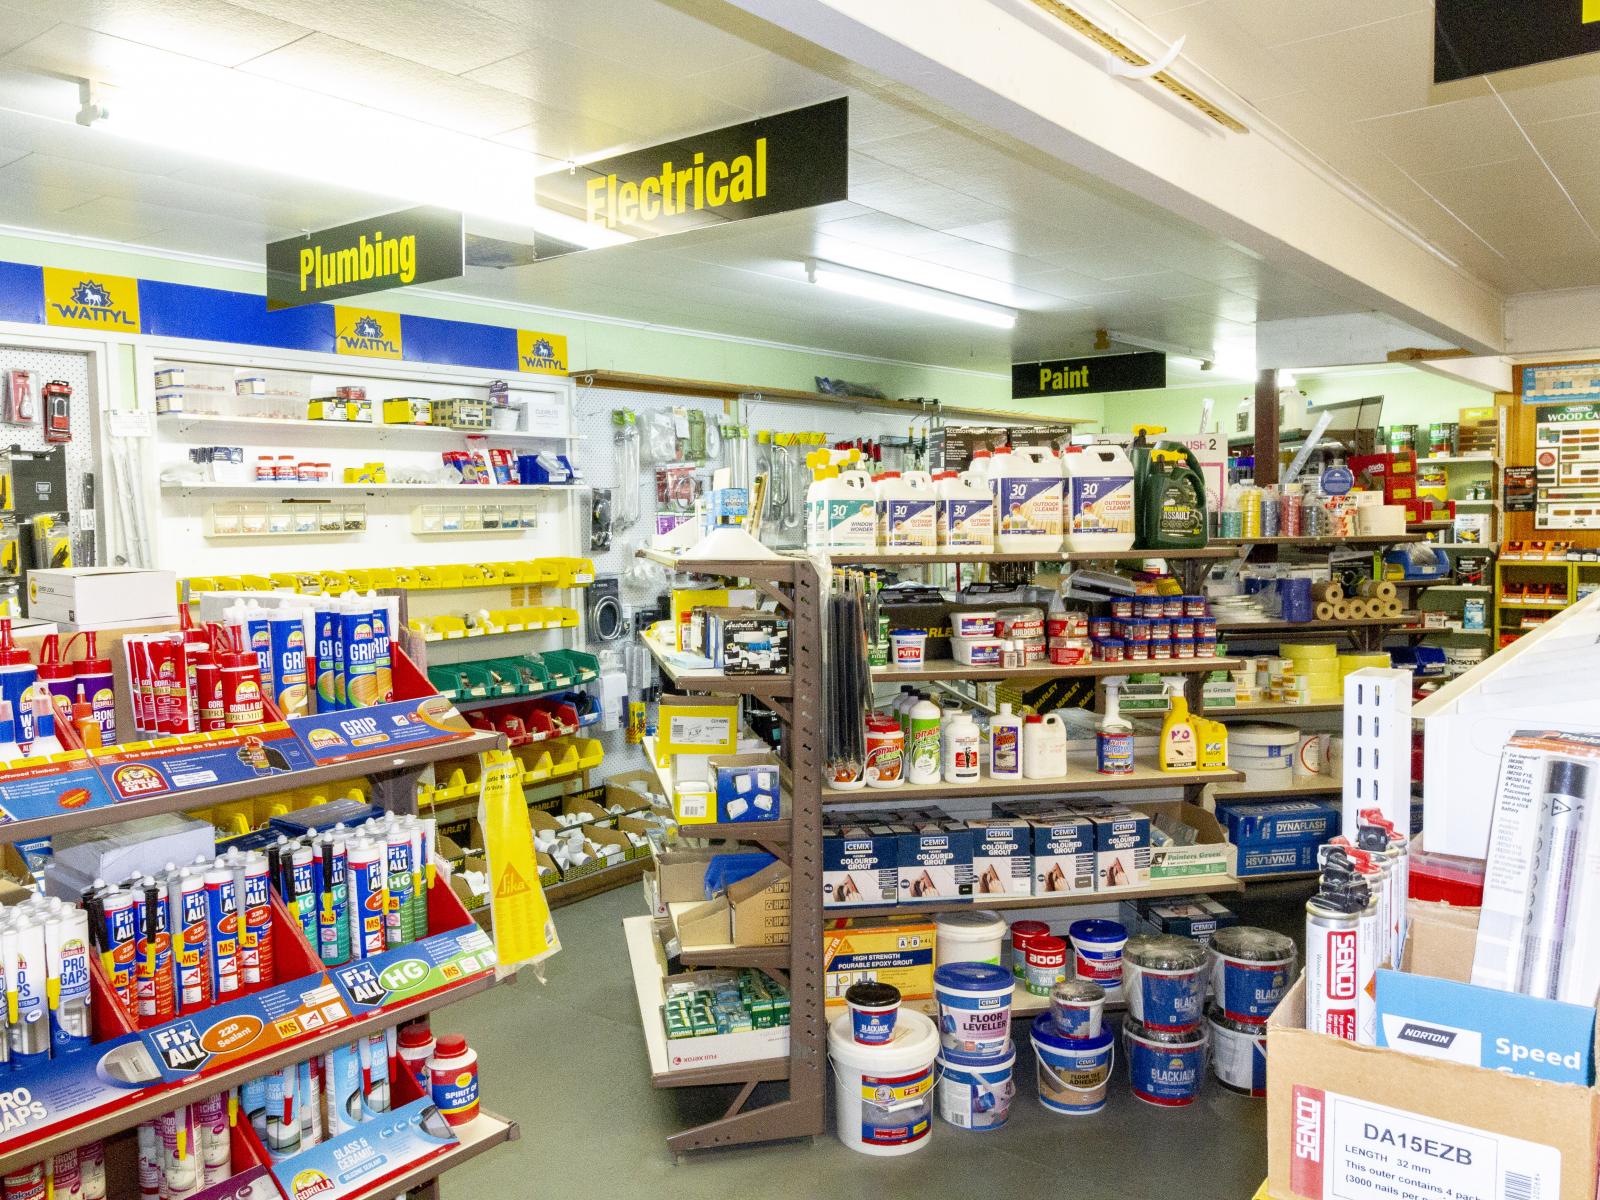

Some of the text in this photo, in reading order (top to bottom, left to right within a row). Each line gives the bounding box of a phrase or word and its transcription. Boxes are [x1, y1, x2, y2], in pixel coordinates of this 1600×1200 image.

[586, 137, 767, 229] Electrical
[300, 231, 417, 292] Plumbing
[52, 302, 136, 326] WATTYL
[341, 335, 399, 355] WATTYL
[521, 355, 567, 371] WATTYL
[1040, 365, 1090, 391] Paint
[1547, 412, 1583, 421] WOOD
[1208, 438, 1216, 450] 2
[1010, 484, 1027, 496] 30
[1082, 483, 1098, 496] 30
[832, 504, 846, 516] 30
[894, 505, 907, 515] 30
[954, 504, 967, 514] 30
[1163, 511, 1190, 520] ASSAULT
[350, 642, 376, 661] GRIP
[283, 652, 306, 671] GRI
[1447, 656, 1480, 666] Resene
[1033, 683, 1058, 709] MARLEY
[1055, 683, 1081, 709] MARLEY
[230, 701, 255, 712] GORILLA
[340, 717, 377, 736] GRIP
[141, 748, 176, 758] Strongest
[218, 738, 240, 746] Planet
[31, 767, 60, 775] Timbers
[121, 776, 160, 788] GORILLA
[124, 782, 162, 794] GLUE
[1503, 787, 1530, 796] Placement
[1053, 828, 1076, 837] CEMIX
[1114, 822, 1134, 832] CEMIX
[1277, 820, 1326, 832] DYNAFLASH
[988, 829, 1011, 838] CEMIX
[1108, 835, 1140, 845] COLOURED
[847, 842, 870, 851] CEMIX
[923, 838, 946, 847] CEMIX
[981, 843, 1019, 851] COLOURED
[1046, 841, 1082, 849] COLOURED
[1114, 841, 1135, 849] GROUT
[389, 847, 407, 860] Fix
[916, 852, 954, 861] COLOURED
[1168, 853, 1197, 861] Painters
[1246, 854, 1296, 866] DYNAFLASH
[389, 857, 408, 871] ALL
[840, 857, 878, 866] COLOURED
[923, 858, 947, 866] GROUT
[293, 867, 311, 879] Fix
[246, 878, 265, 892] Fix
[295, 878, 312, 893] ALL
[389, 874, 411, 889] HG
[499, 875, 526, 895] Sika
[186, 893, 205, 909] Fix
[246, 890, 266, 907] ALL
[251, 909, 264, 918] 220
[366, 919, 380, 930] MS
[1193, 923, 1214, 932] CEMIX
[220, 942, 235, 953] MS
[63, 956, 85, 973] PRO
[182, 953, 198, 965] MS
[838, 961, 871, 970] POURABLE
[892, 958, 914, 966] GROUT
[1336, 934, 1355, 997] SENCO
[60, 967, 88, 986] GAPS
[341, 966, 373, 986] Fix
[385, 961, 422, 988] HG
[443, 965, 460, 979] MS
[353, 979, 381, 1001] ALL
[970, 1012, 1003, 1023] FLOOR
[217, 1022, 239, 1037] 220
[278, 1022, 299, 1037] MS
[861, 1023, 889, 1033] BLACKJACK
[963, 1020, 1007, 1032] LEVELLER
[1346, 1014, 1354, 1041] FUE
[156, 1027, 197, 1051] Fix
[217, 1026, 253, 1048] Sealant
[1404, 1027, 1450, 1044] NORTON
[169, 1045, 208, 1068] ALL
[1495, 1037, 1582, 1071] Speed
[1151, 1068, 1196, 1082] BLACKJACK
[0, 1087, 32, 1113] RO
[444, 1089, 470, 1101] SPIRIT
[451, 1093, 475, 1107] SALTS
[1296, 1095, 1321, 1164] SENCO
[333, 1140, 361, 1160] GLASS
[1363, 1122, 1473, 1166] DA15EZB
[337, 1145, 376, 1169] CERAMIC
[1345, 1144, 1431, 1175] LENGTH 32 mm
[1345, 1159, 1453, 1196] This outer contains 4
[295, 1180, 335, 1200] GORILLA
[1345, 1173, 1419, 1200] (3000 nails per
